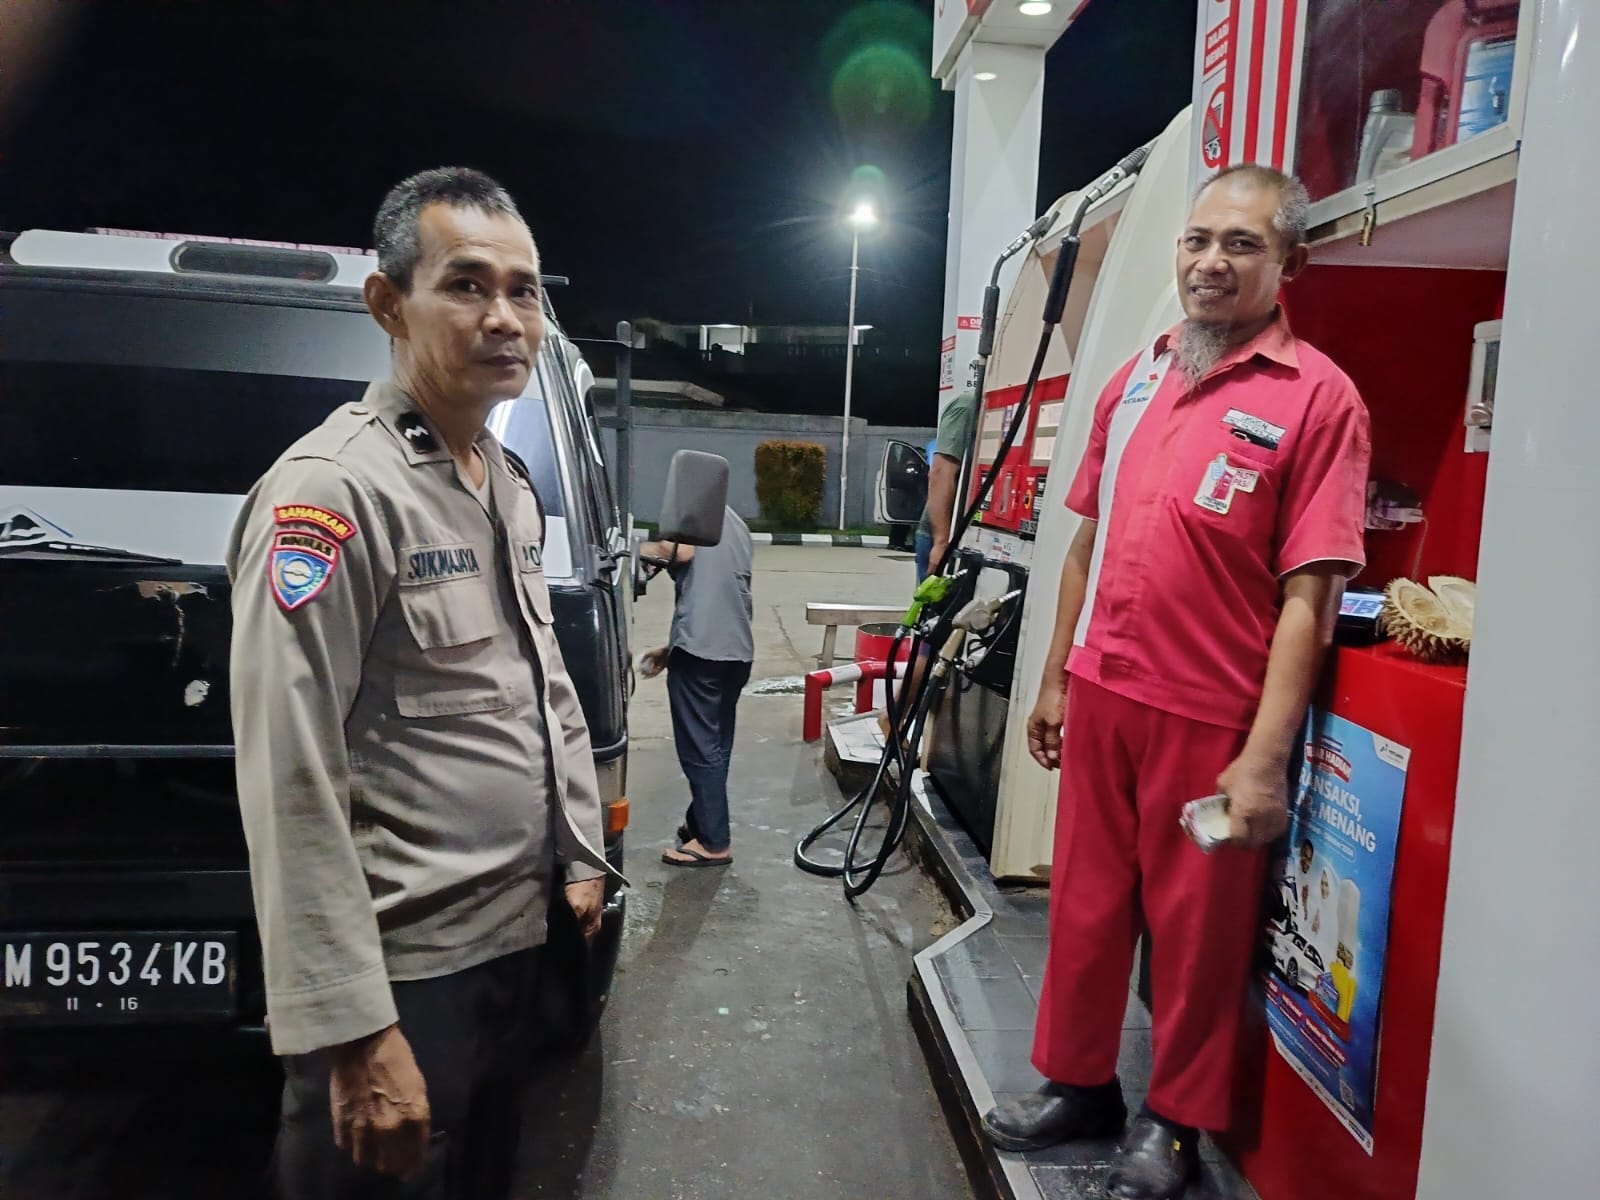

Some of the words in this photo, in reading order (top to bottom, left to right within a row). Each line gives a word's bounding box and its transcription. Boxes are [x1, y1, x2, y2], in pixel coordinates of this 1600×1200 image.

[1299, 766, 1362, 822] RANSAKSI,
[1319, 801, 1376, 853] MENANG
[5, 943, 31, 987] M
[120, 997, 138, 1011] 16
